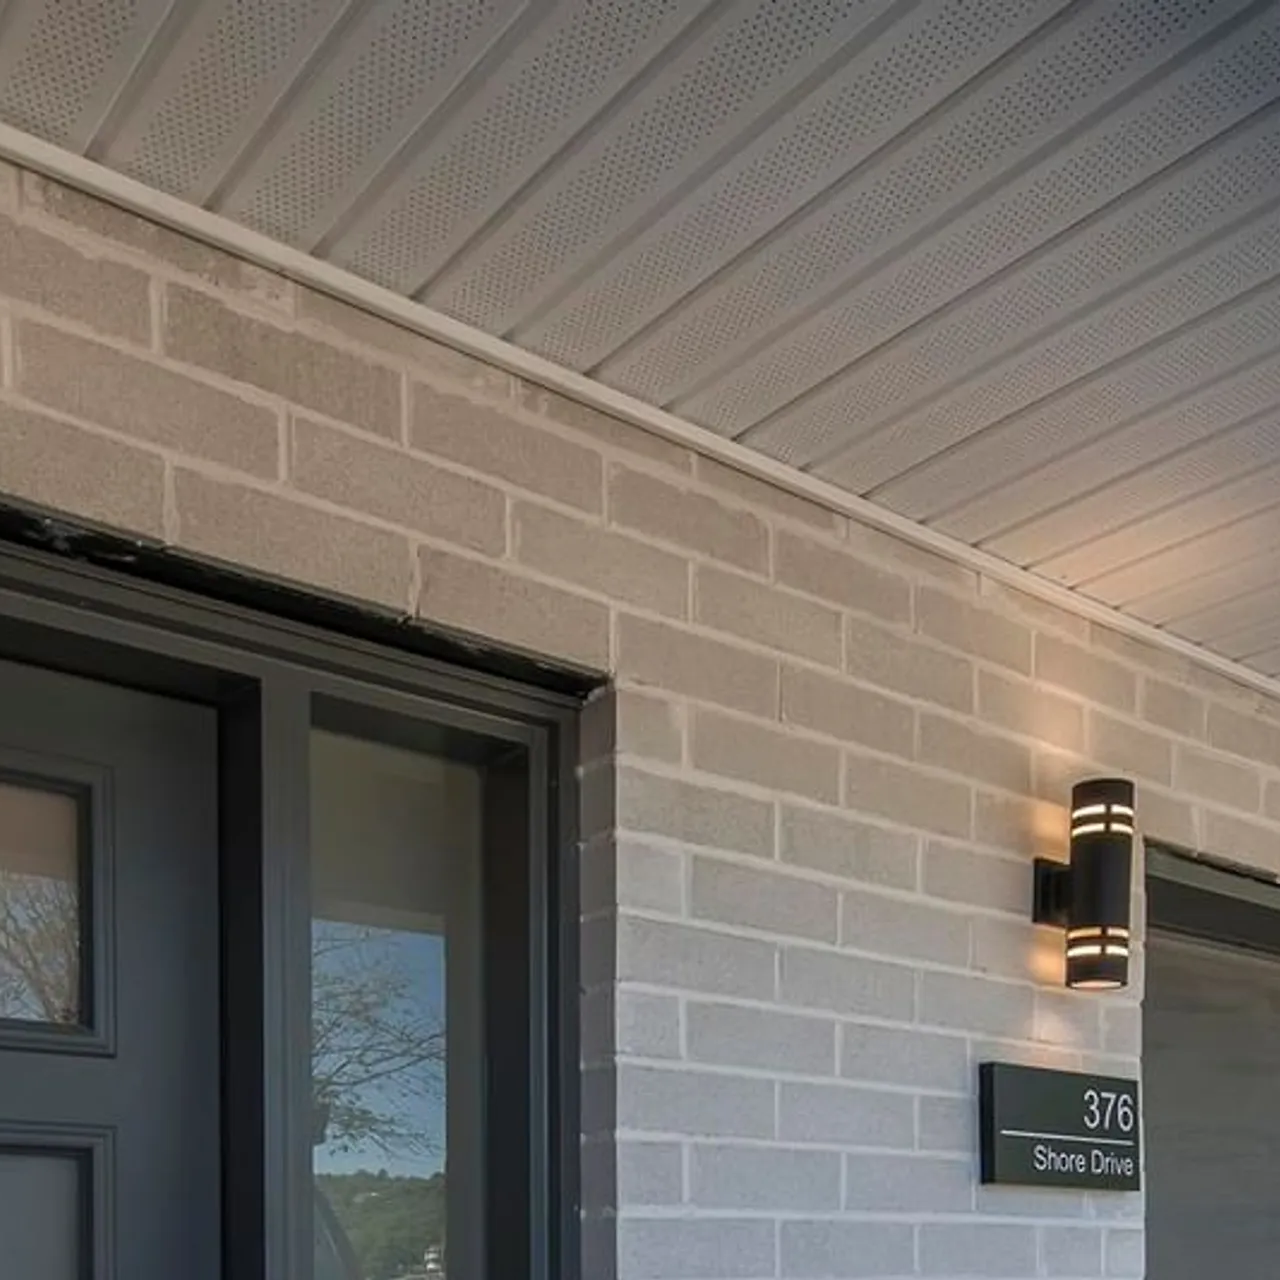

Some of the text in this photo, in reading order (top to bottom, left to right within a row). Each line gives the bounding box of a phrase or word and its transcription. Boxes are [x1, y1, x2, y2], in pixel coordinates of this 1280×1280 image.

[1083, 1089, 1134, 1132] 376
[1033, 1144, 1134, 1176] Shore Drive
